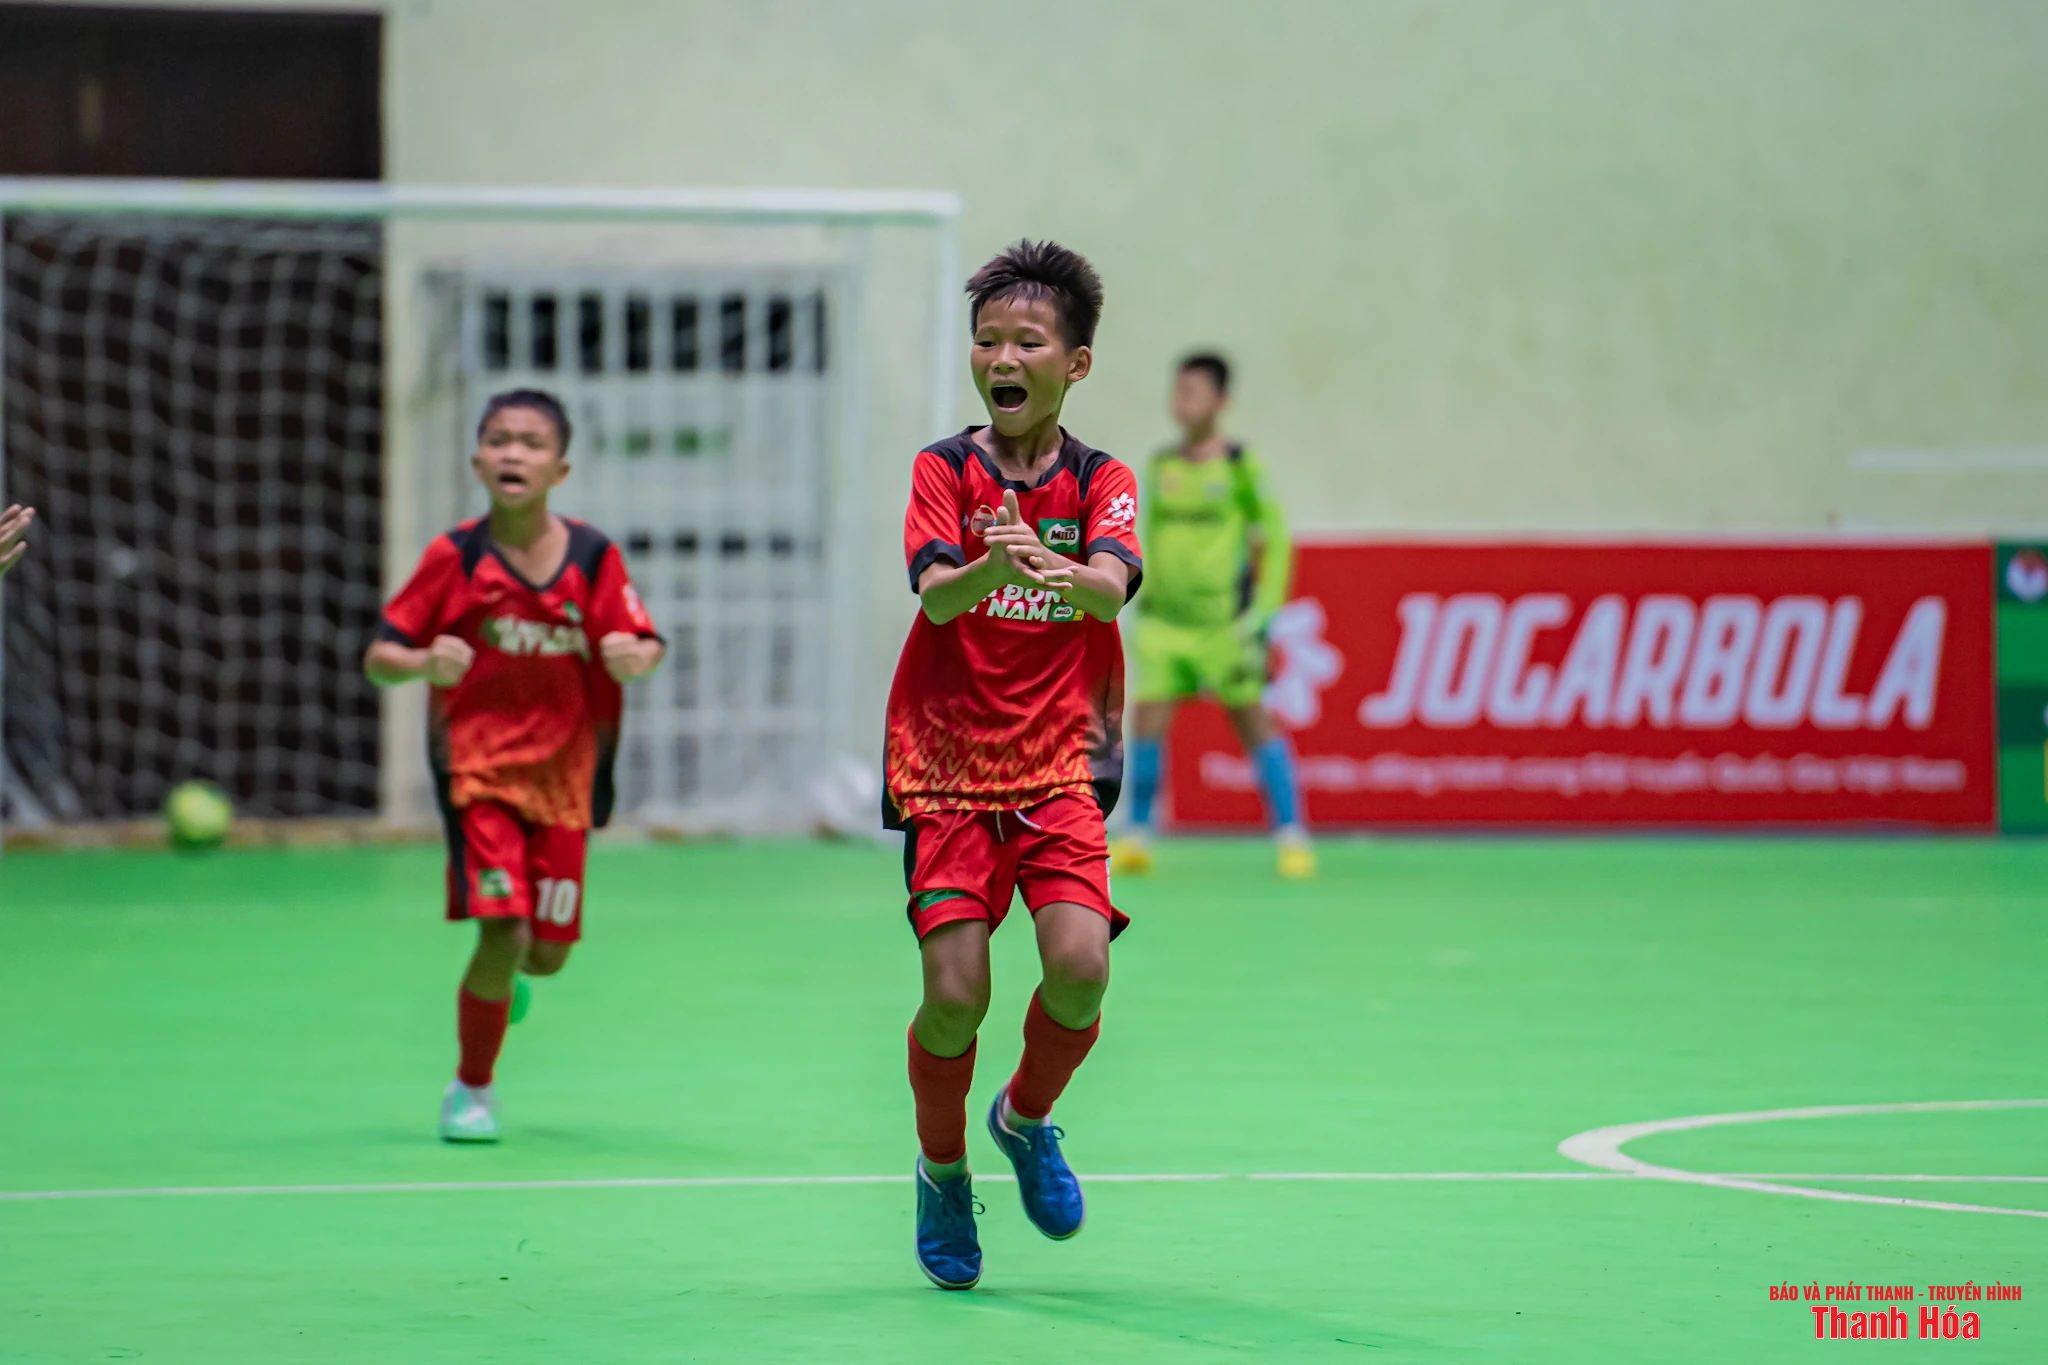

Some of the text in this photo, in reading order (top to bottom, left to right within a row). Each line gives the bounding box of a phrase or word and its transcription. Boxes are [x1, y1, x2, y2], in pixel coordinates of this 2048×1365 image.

[1050, 530, 1076, 540] MILO
[986, 598, 1051, 621] NAM
[1359, 595, 1945, 728] JOGARBOLA
[535, 877, 578, 926] 10
